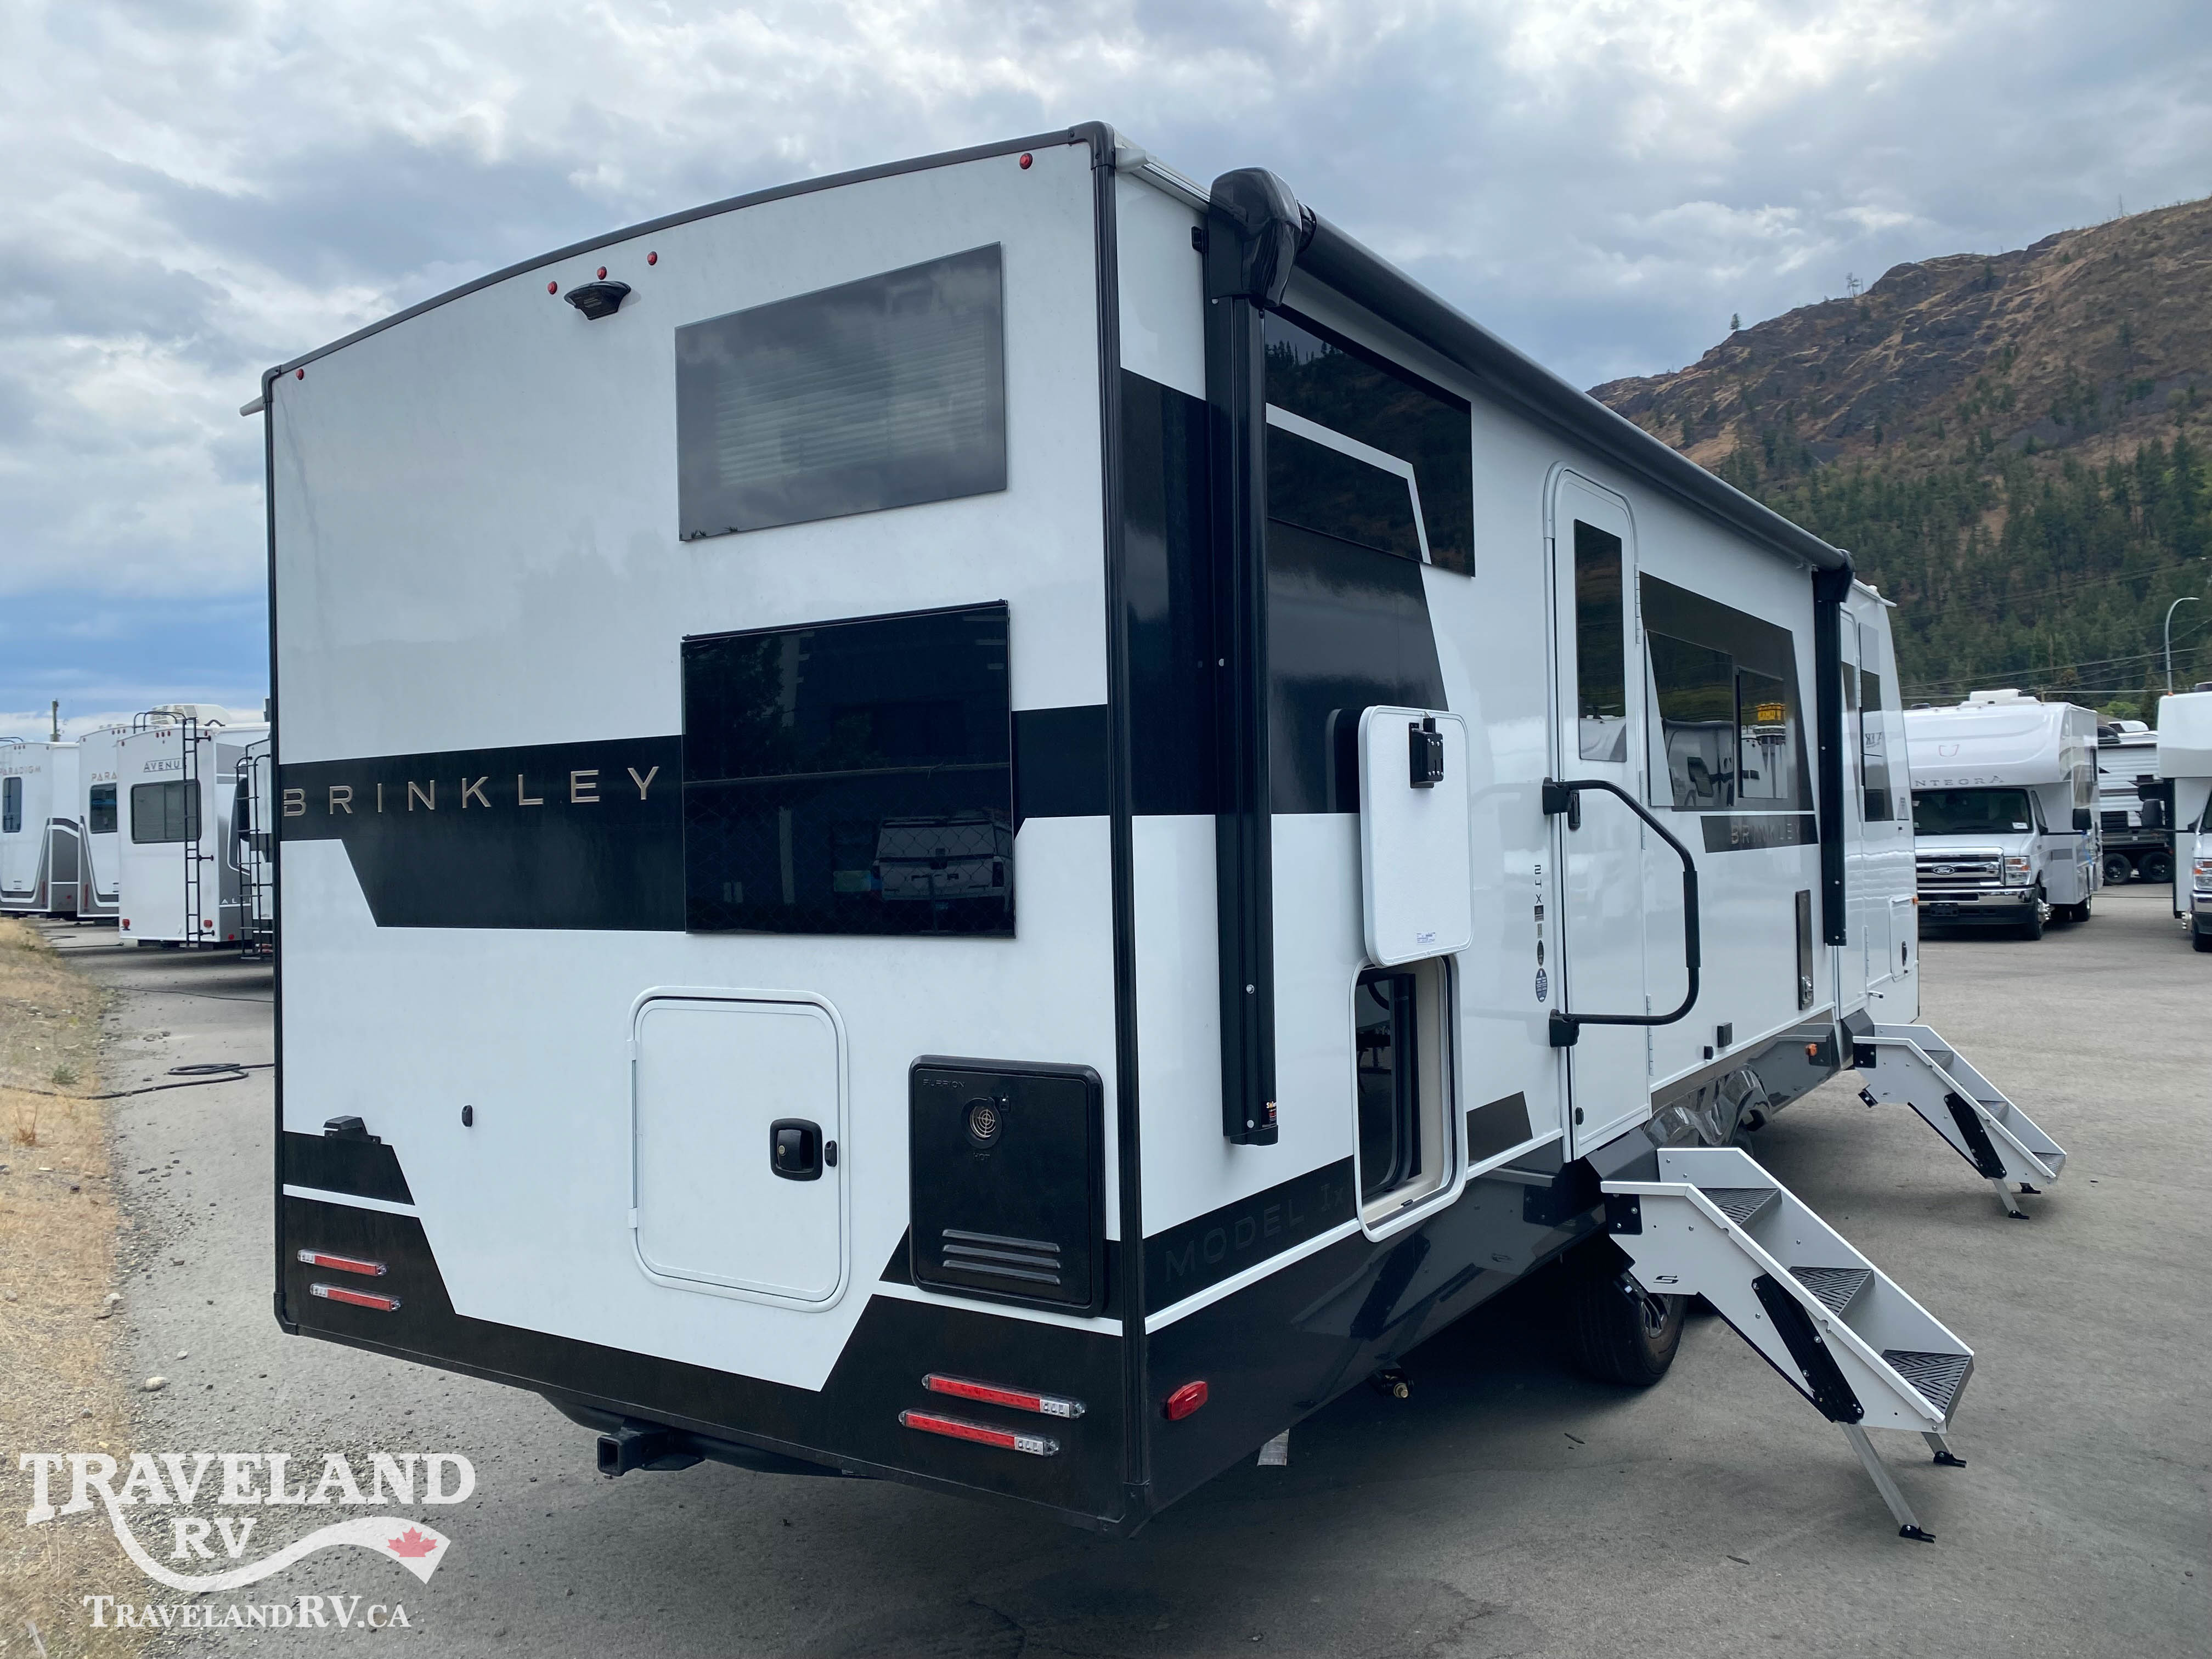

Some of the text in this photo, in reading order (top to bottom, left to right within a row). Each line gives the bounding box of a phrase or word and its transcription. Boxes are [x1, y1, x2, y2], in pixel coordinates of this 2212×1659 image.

[143, 759, 186, 772] AVENU
[283, 766, 659, 817] BRINKLEY
[1166, 1199, 1304, 1282] MODEL
